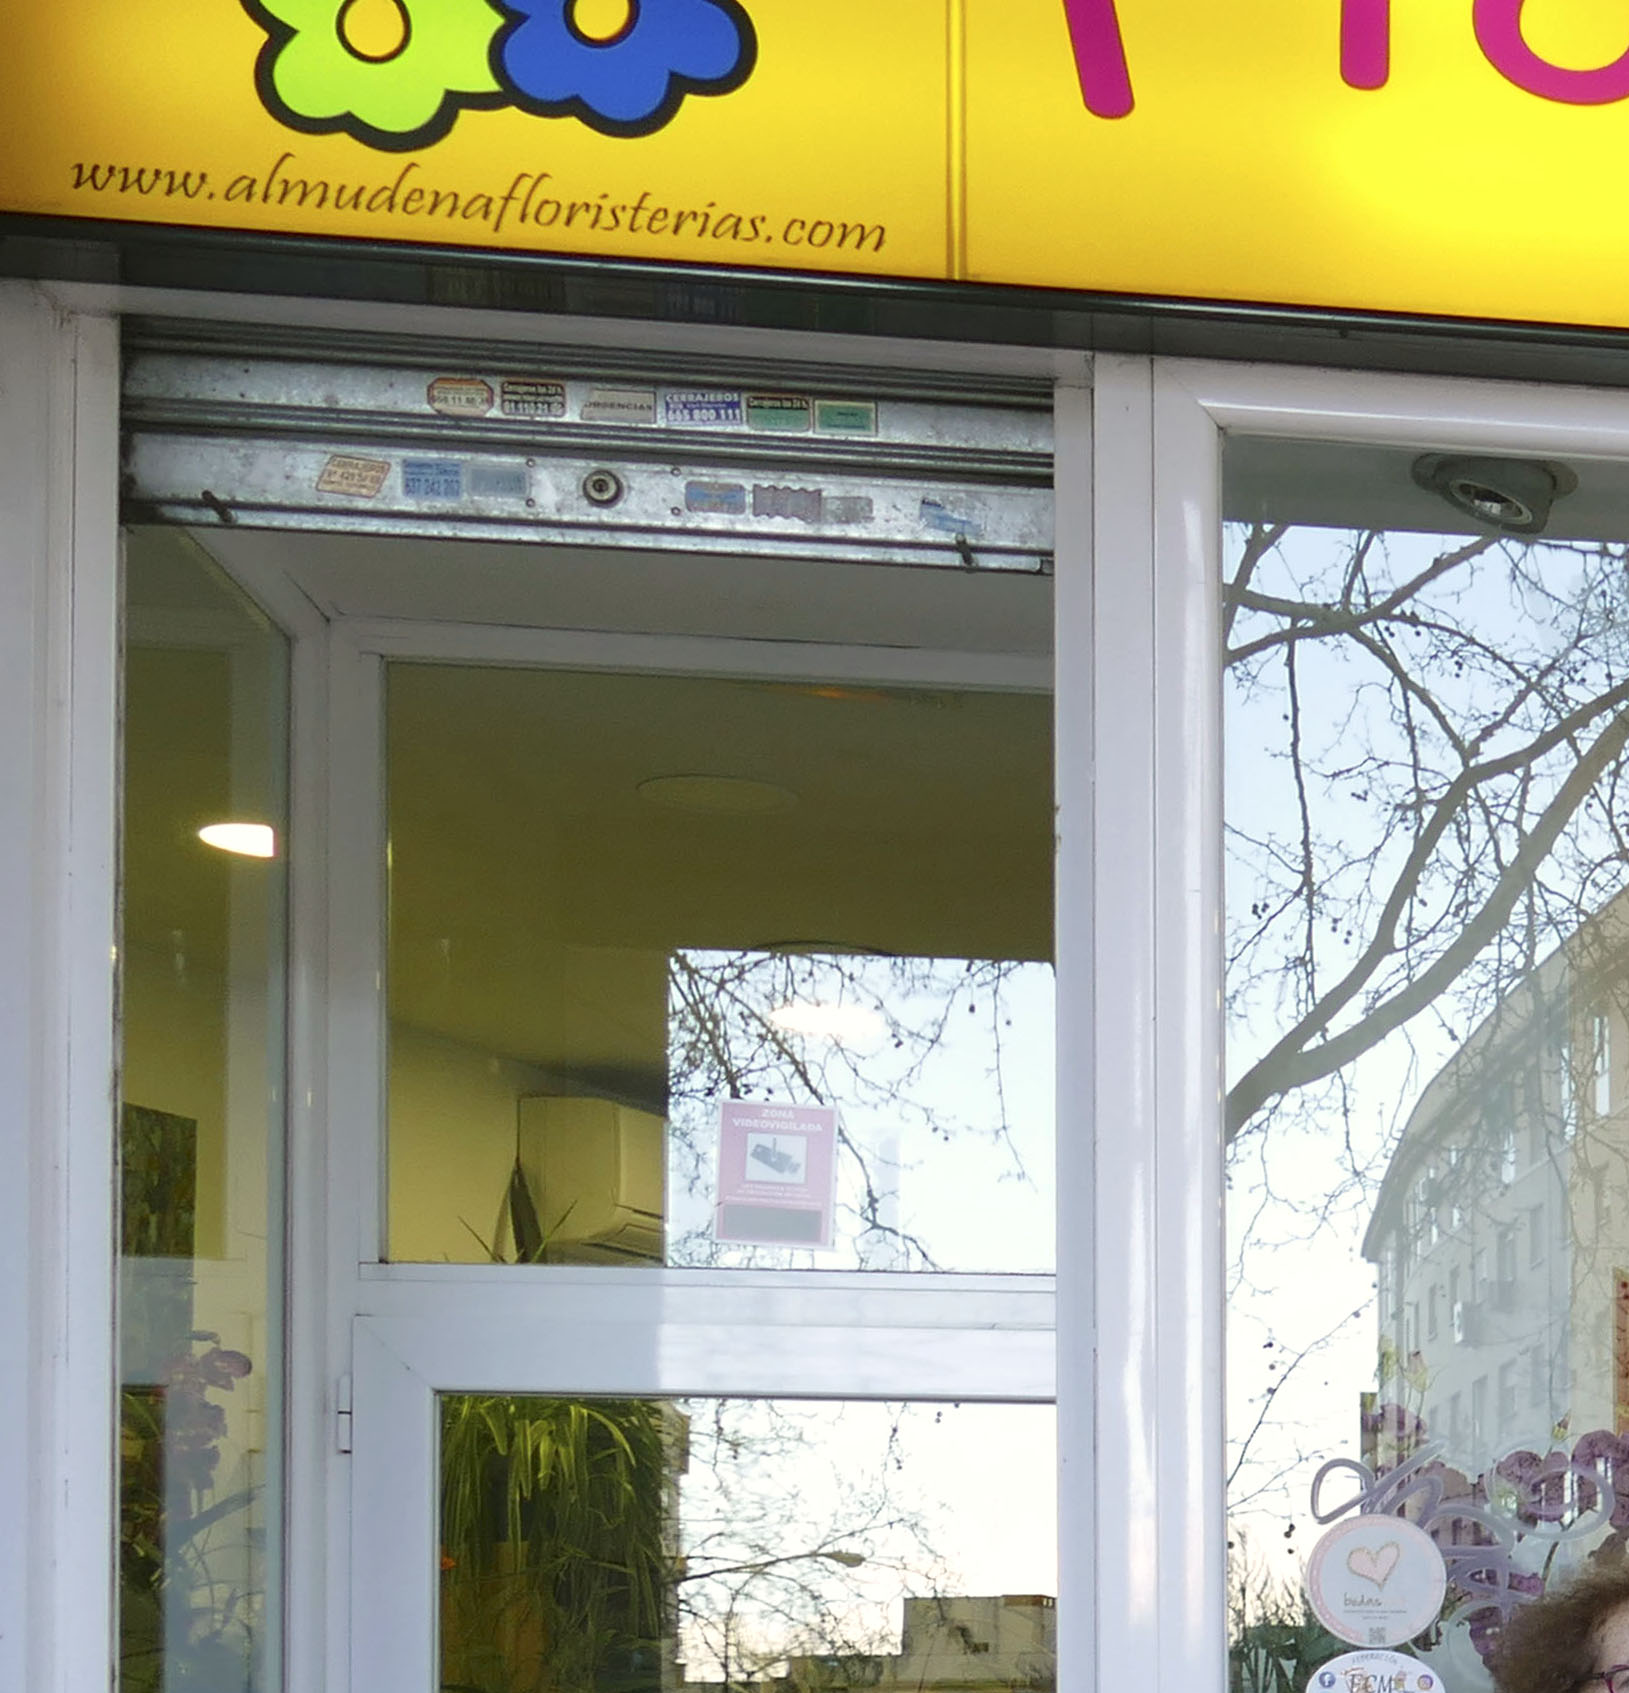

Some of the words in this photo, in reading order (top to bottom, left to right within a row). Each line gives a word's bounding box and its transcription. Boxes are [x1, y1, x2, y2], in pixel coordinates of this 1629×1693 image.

[71, 153, 886, 254] www.almudenafloristerias.com
[762, 1108, 795, 1119] ZONA
[732, 1117, 823, 1132] VIDEOVIGILADA
